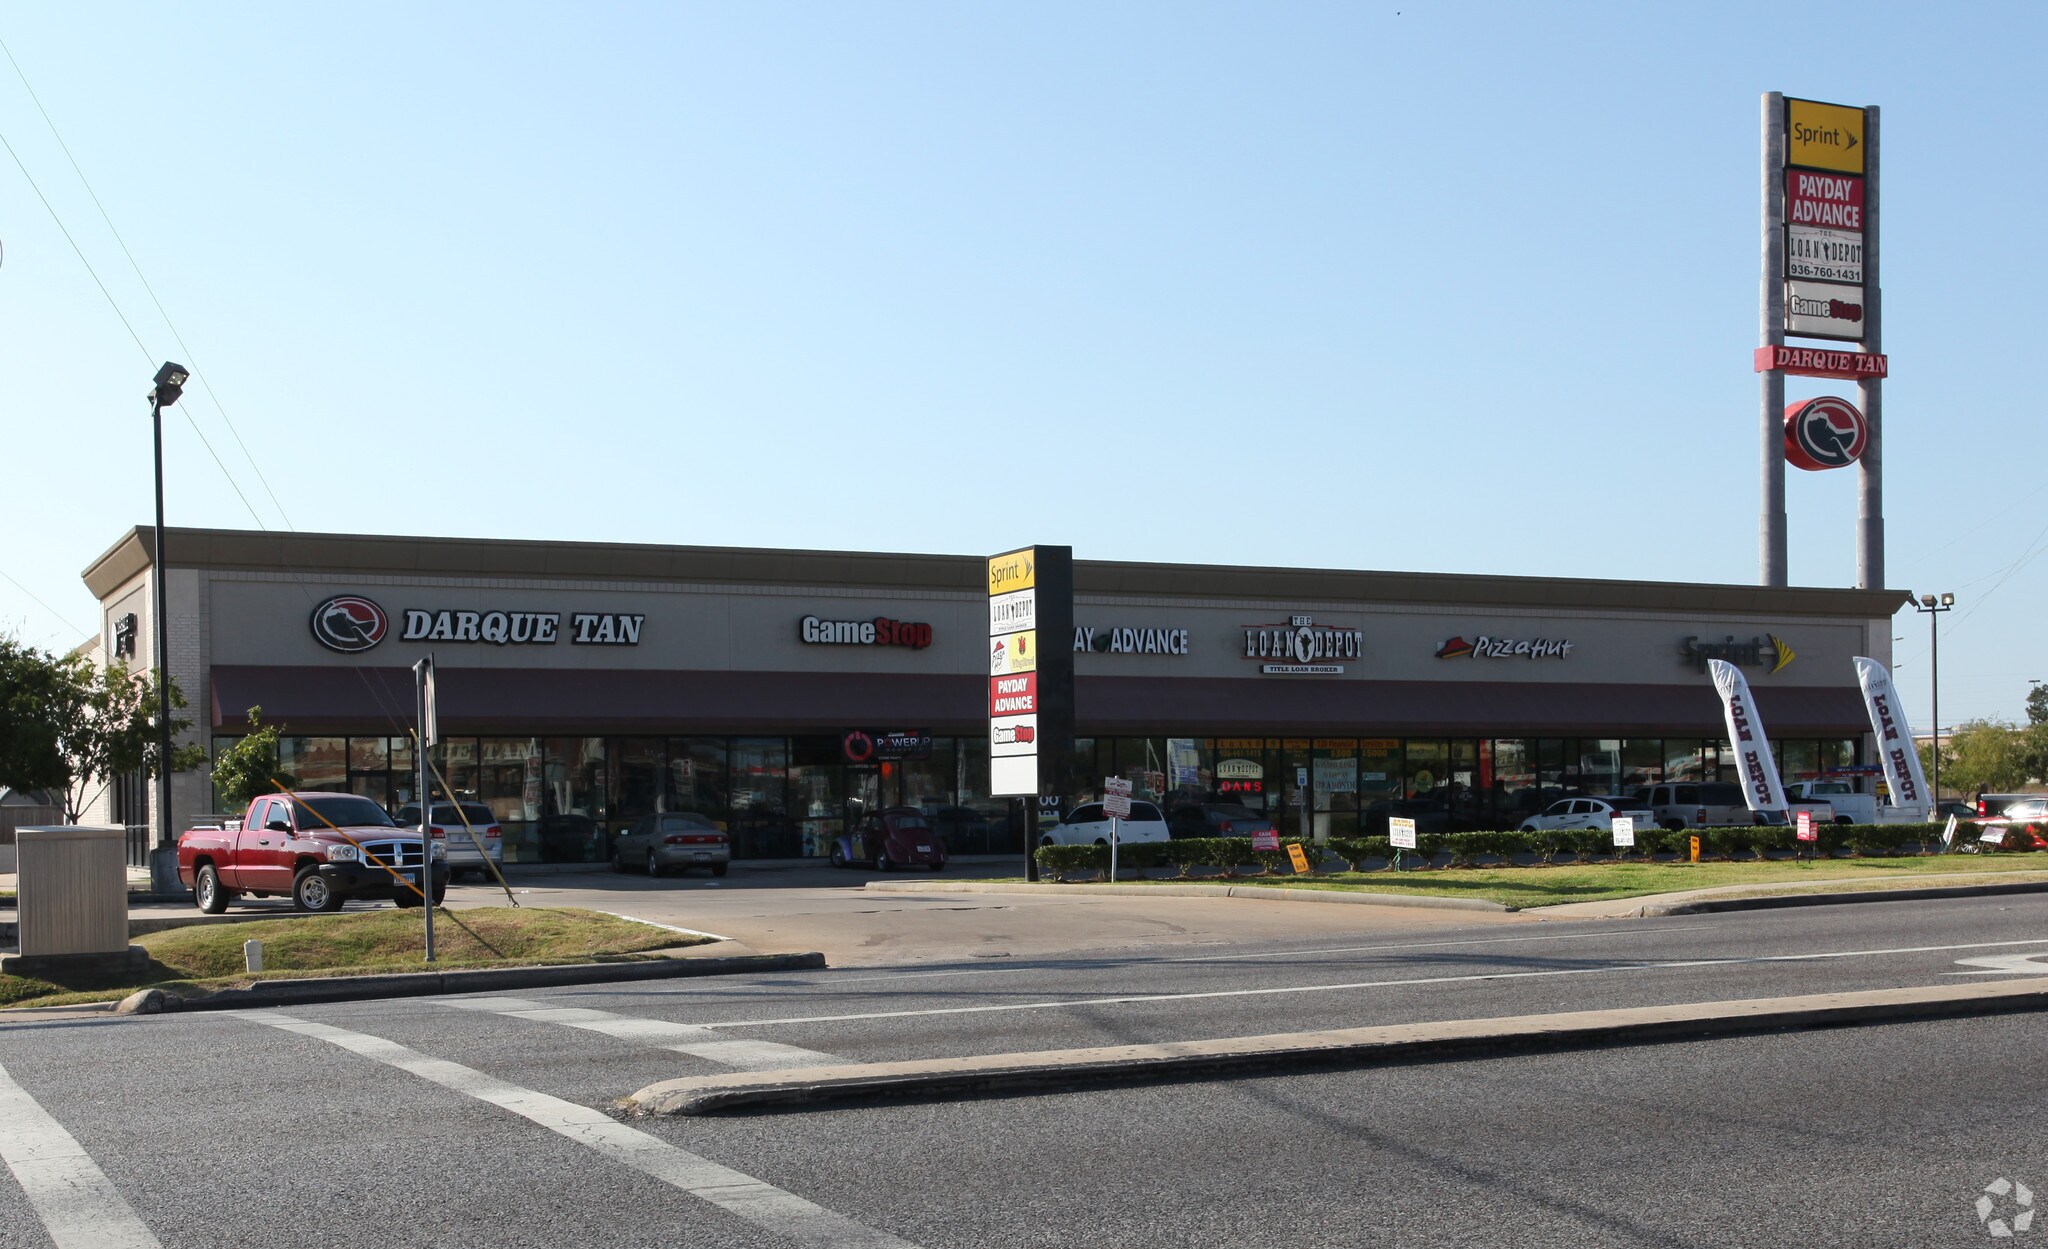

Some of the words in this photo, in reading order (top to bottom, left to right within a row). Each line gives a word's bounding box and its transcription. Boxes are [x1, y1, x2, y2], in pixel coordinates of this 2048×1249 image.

[1795, 122, 1840, 147] Sprint
[1799, 174, 1852, 202] PAYDAY
[1792, 199, 1860, 228] ADVANCE
[1790, 238, 1819, 259] LOAN
[1832, 244, 1861, 263] DEPOT
[1791, 265, 1860, 281] 936-760-1431
[1790, 295, 1862, 322] GameStop
[1776, 349, 1850, 371] DARQUE
[1855, 355, 1887, 373] TAN
[992, 560, 1019, 588] Sprint
[994, 604, 1009, 622] LOAN
[1016, 599, 1032, 618] DEPOT
[1293, 617, 1312, 626] THE
[402, 611, 560, 645] DARQUE
[573, 613, 645, 644] TAN
[801, 616, 932, 648] GameStop
[1110, 628, 1188, 655] ADVANCE
[1245, 631, 1295, 657] LOAN
[1314, 631, 1363, 658] DEPOT
[1680, 635, 1764, 674] Sprint
[998, 678, 1028, 695] PAYDAY
[994, 696, 1033, 712] ADVANCE
[993, 725, 1035, 744] GameStop
[1873, 694, 1899, 741] LOAN
[1890, 748, 1918, 801] DEPOT
[1730, 695, 1752, 742] LOAN
[1745, 751, 1772, 804] DEPOT
